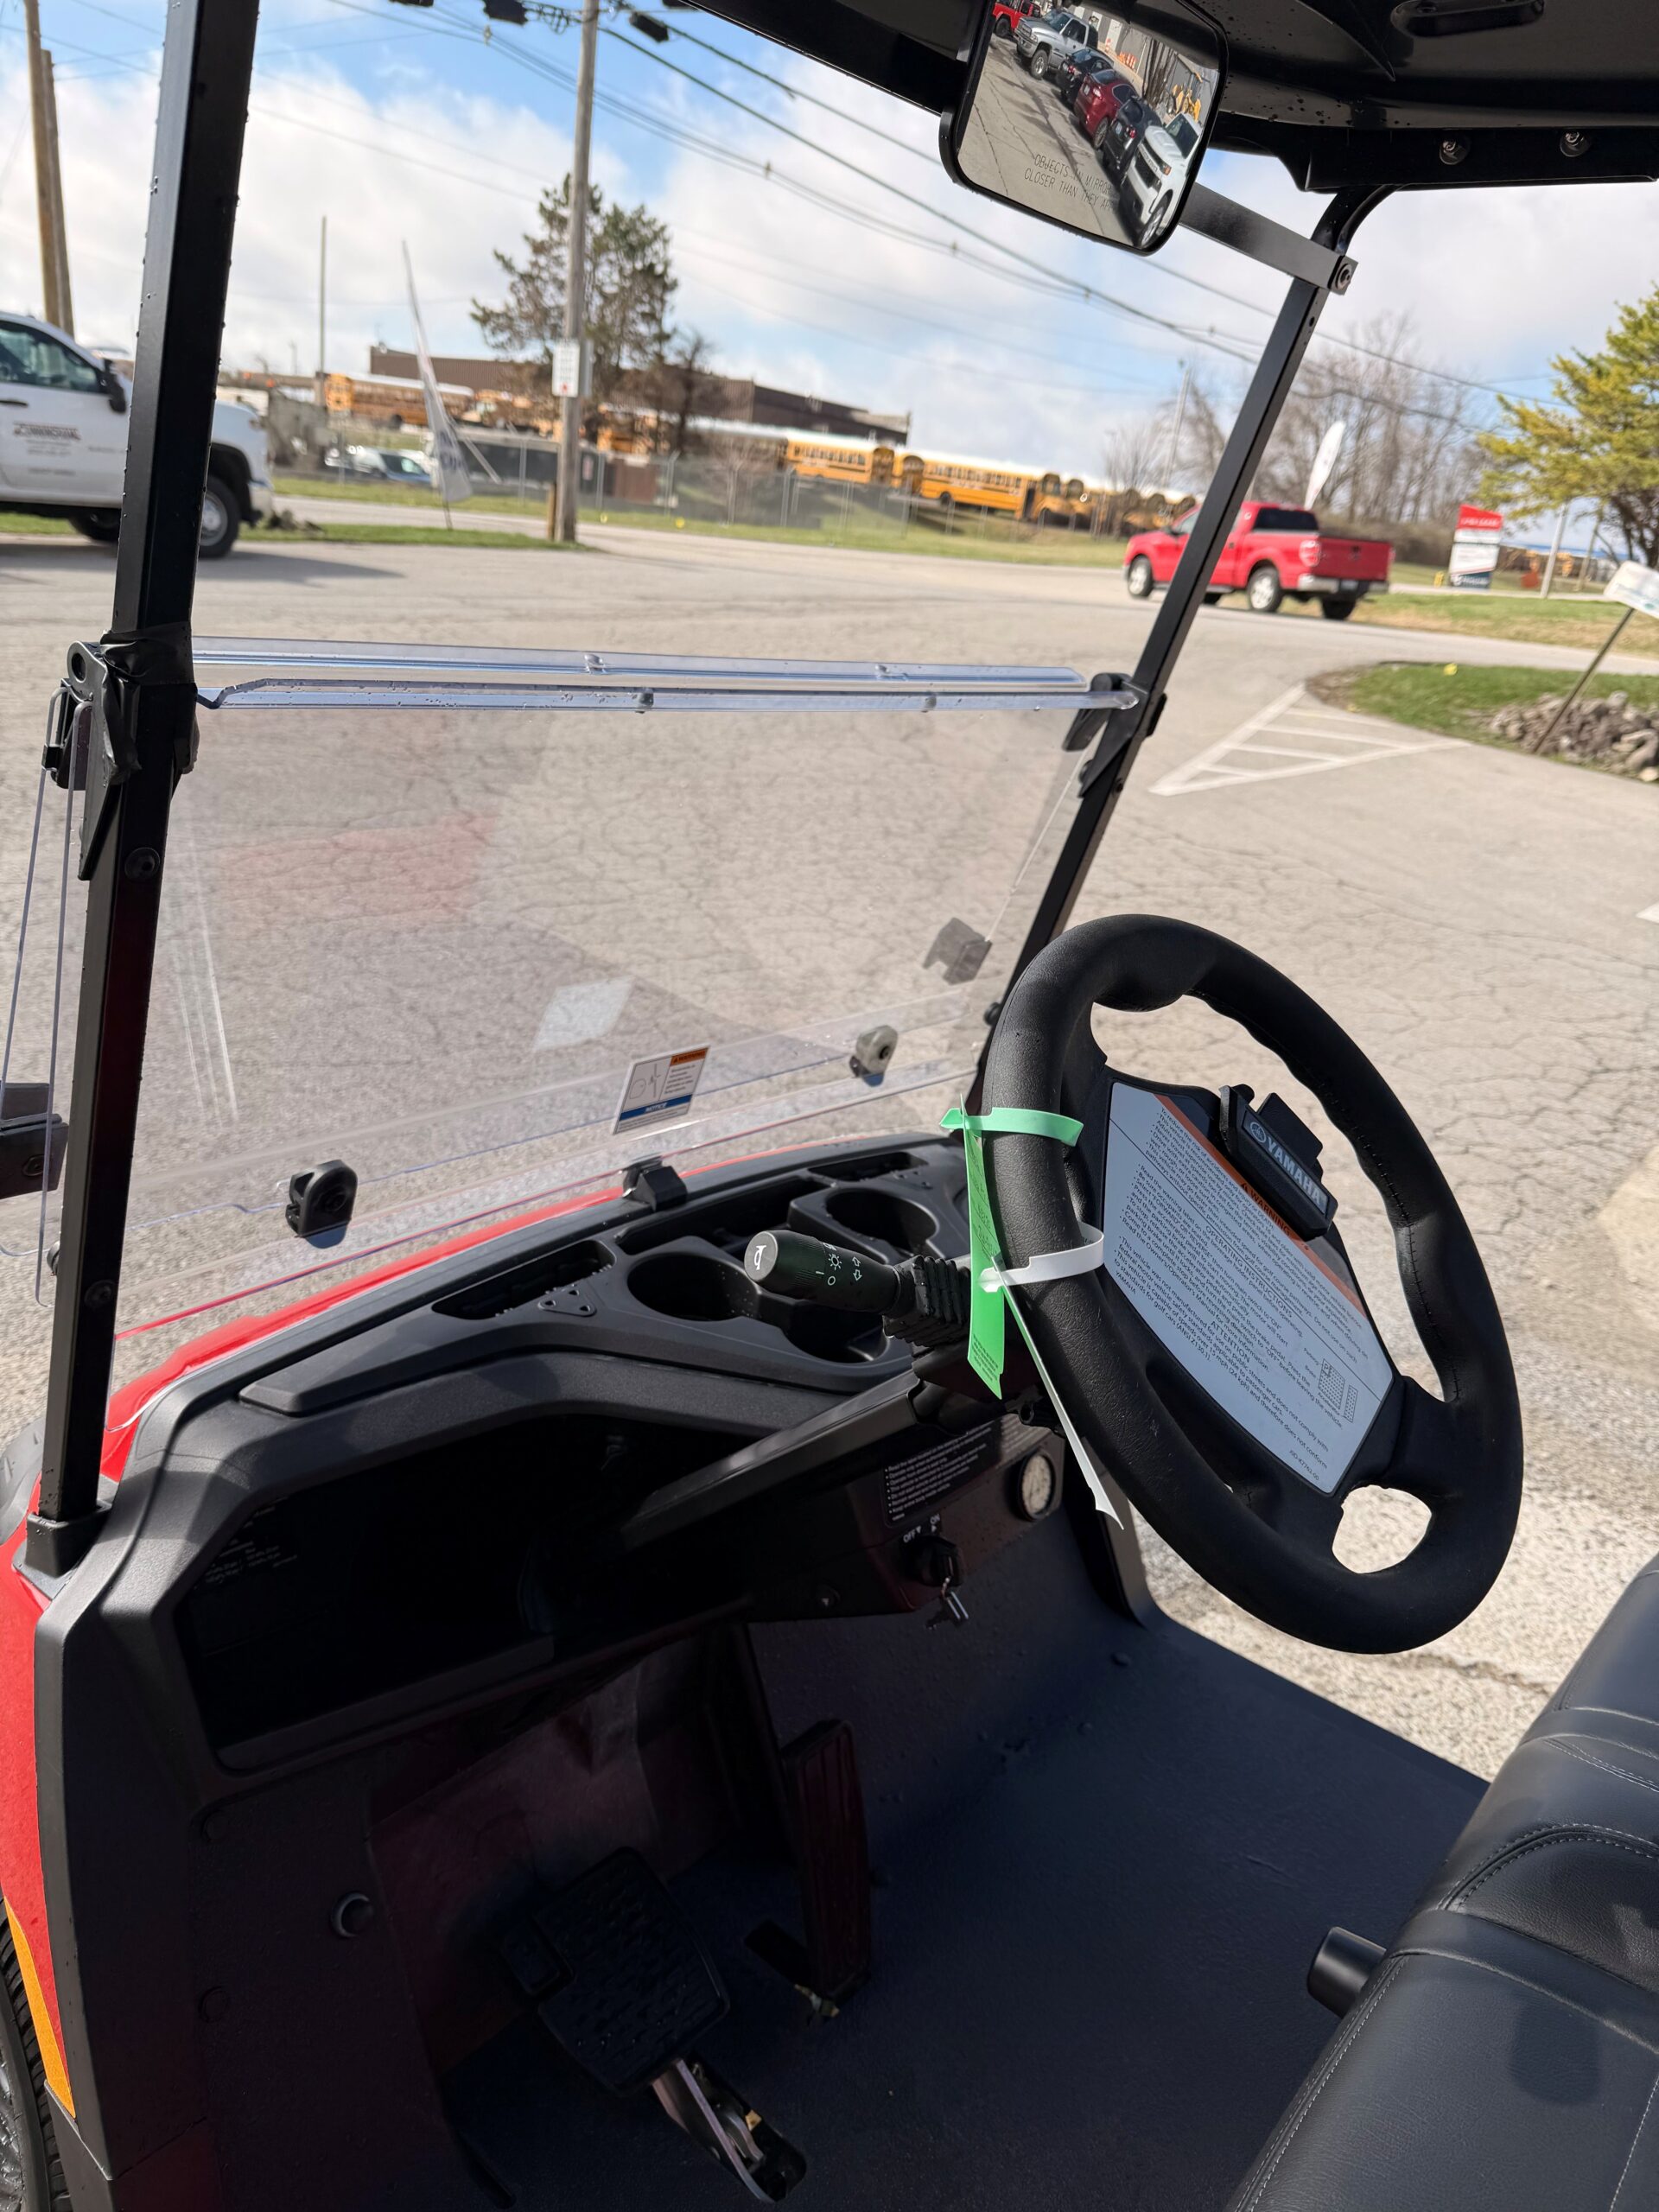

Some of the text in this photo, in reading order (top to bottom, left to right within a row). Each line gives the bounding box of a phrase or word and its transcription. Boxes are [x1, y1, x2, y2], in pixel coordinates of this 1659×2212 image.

[1024, 168, 1055, 188] CLOSER
[1058, 181, 1078, 198] THAN
[1081, 192, 1099, 207] THEY
[1034, 154, 1070, 177] OBJECTS
[1085, 175, 1112, 195] MIRROR
[1145, 1179, 1157, 1193] sure
[1156, 1191, 1182, 1220] occupants
[1182, 1217, 1191, 1230] are
[1249, 1189, 1290, 1236] WARNING
[1268, 1137, 1321, 1205] YAMAHA
[1122, 1216, 1136, 1235] Read
[1135, 1230, 1146, 1244] the
[1195, 1293, 1216, 1317] Manual
[1215, 1313, 1224, 1325] for
[1223, 1322, 1237, 1340] more
[1124, 1209, 1141, 1230] Come
[1151, 1239, 1176, 1268] complete
[1176, 1265, 1188, 1282] stop
[1188, 1276, 1205, 1299] before
[1205, 1296, 1230, 1325] reversing
[1130, 1190, 1142, 1205] and
[1141, 1201, 1151, 1215] the
[1150, 1211, 1172, 1237] parking
[1171, 1232, 1186, 1252] brake
[1185, 1249, 1197, 1262] will
[1196, 1259, 1215, 1281] release
[1133, 1183, 1147, 1202] Press
[1147, 1198, 1157, 1211] the
[1156, 1208, 1185, 1242] accelerator
[1185, 1238, 1201, 1257] pedal
[1206, 1261, 1219, 1276] start
[1239, 1294, 1250, 1308] The
[1249, 1305, 1266, 1325] motor
[1266, 1321, 1276, 1334] will
[1275, 1332, 1287, 1346] start
[1135, 1176, 1152, 1197] Select
[1211, 1256, 1224, 1273] then
[1223, 1268, 1235, 1284] turn
[1234, 1281, 1248, 1297] main
[1247, 1294, 1263, 1313] switch
[1205, 1224, 1293, 1319] OPERATING INSTRUCTIONS
[1115, 1269, 1136, 1294] YAMAHA
[1118, 1243, 1137, 1266] federal
[1136, 1263, 1154, 1283] motor
[1153, 1280, 1172, 1302] vehicle
[1172, 1300, 1187, 1319] safety
[1187, 1315, 1213, 1344] standards
[1212, 1341, 1239, 1371] applicable
[1244, 1375, 1271, 1404] passenger
[1120, 1265, 1146, 1294] standards
[1145, 1291, 1154, 1303] for
[1153, 1300, 1165, 1314] golf
[1164, 1311, 1176, 1325] cars
[1175, 1321, 1191, 1341] (ANSI
[1125, 1204, 1147, 1230] parking
[1147, 1224, 1162, 1244] brake
[1161, 1241, 1175, 1257] until
[1194, 1274, 1205, 1288] and
[1205, 1285, 1217, 1300] turn
[1217, 1297, 1226, 1311] the
[1226, 1307, 1240, 1325] main
[1240, 1322, 1257, 1342] switch
[1278, 1360, 1296, 1382] before
[1295, 1377, 1314, 1402] leaving
[1314, 1397, 1324, 1410] the
[1148, 1218, 1168, 1241] release
[1167, 1237, 1178, 1250] the
[1177, 1248, 1206, 1281] accelerator
[1205, 1277, 1221, 1296] pedal
[1220, 1293, 1232, 1306] and
[1230, 1304, 1246, 1321] press
[1245, 1318, 1255, 1331] the
[1255, 1327, 1270, 1346] brake
[1287, 1359, 1301, 1377] Press
[1300, 1374, 1310, 1387] the
[1116, 1249, 1128, 1266] This
[1127, 1262, 1146, 1285] vehicle
[1151, 1287, 1172, 1312] capable
[1178, 1315, 1197, 1338] speeds
[1196, 1334, 1209, 1350] over
[1215, 1354, 1229, 1370] mph
[1228, 1365, 1237, 1379] (24
[1236, 1375, 1249, 1393] kph)
[1249, 1389, 1261, 1402] and
[1260, 1398, 1283, 1426] therefore
[1283, 1421, 1296, 1439] does
[1296, 1435, 1306, 1448] not
[1306, 1445, 1327, 1469] conform
[1121, 1236, 1132, 1252] This
[1132, 1249, 1151, 1271] vehicle
[1150, 1268, 1161, 1282] was
[1161, 1279, 1171, 1292] not
[1171, 1289, 1207, 1329] manufactured
[1206, 1325, 1215, 1337] for
[1214, 1334, 1224, 1347] use
[1231, 1351, 1249, 1371] public
[1248, 1369, 1266, 1389] streets
[1265, 1386, 1276, 1400] and
[1275, 1395, 1288, 1413] does
[1288, 1409, 1298, 1422] not
[1298, 1419, 1317, 1442] comply
[1316, 1438, 1329, 1452] with
[1210, 1319, 1250, 1363] ATTENTION
[903, 1529, 915, 1543] OFF
[930, 1513, 940, 1525] ON
